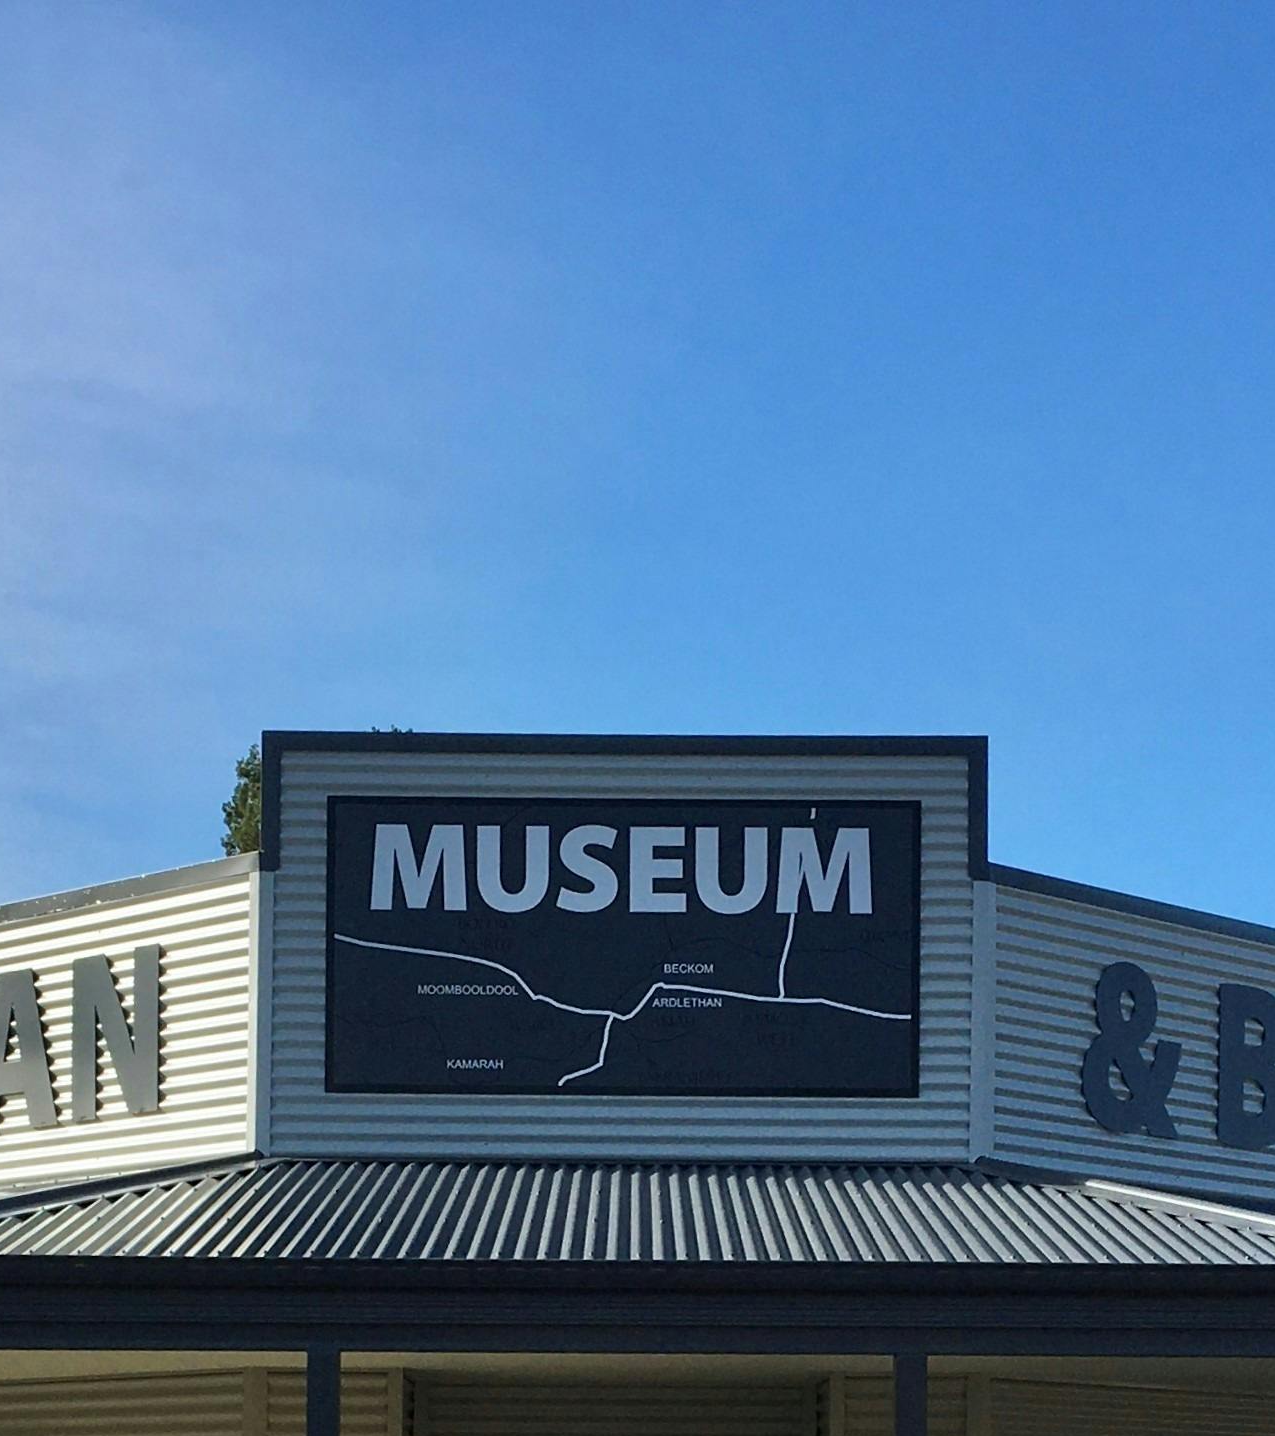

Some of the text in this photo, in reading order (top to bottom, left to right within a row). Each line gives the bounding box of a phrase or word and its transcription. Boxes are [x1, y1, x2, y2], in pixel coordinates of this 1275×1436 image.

[370, 823, 874, 915] MUSEUM
[663, 963, 714, 974] BECKOM
[417, 984, 519, 996] MOOMBOOLDOOL
[652, 997, 723, 1008] ARDLETHAN
[1081, 961, 1183, 1139] &
[446, 1058, 504, 1070] KAMARAH
